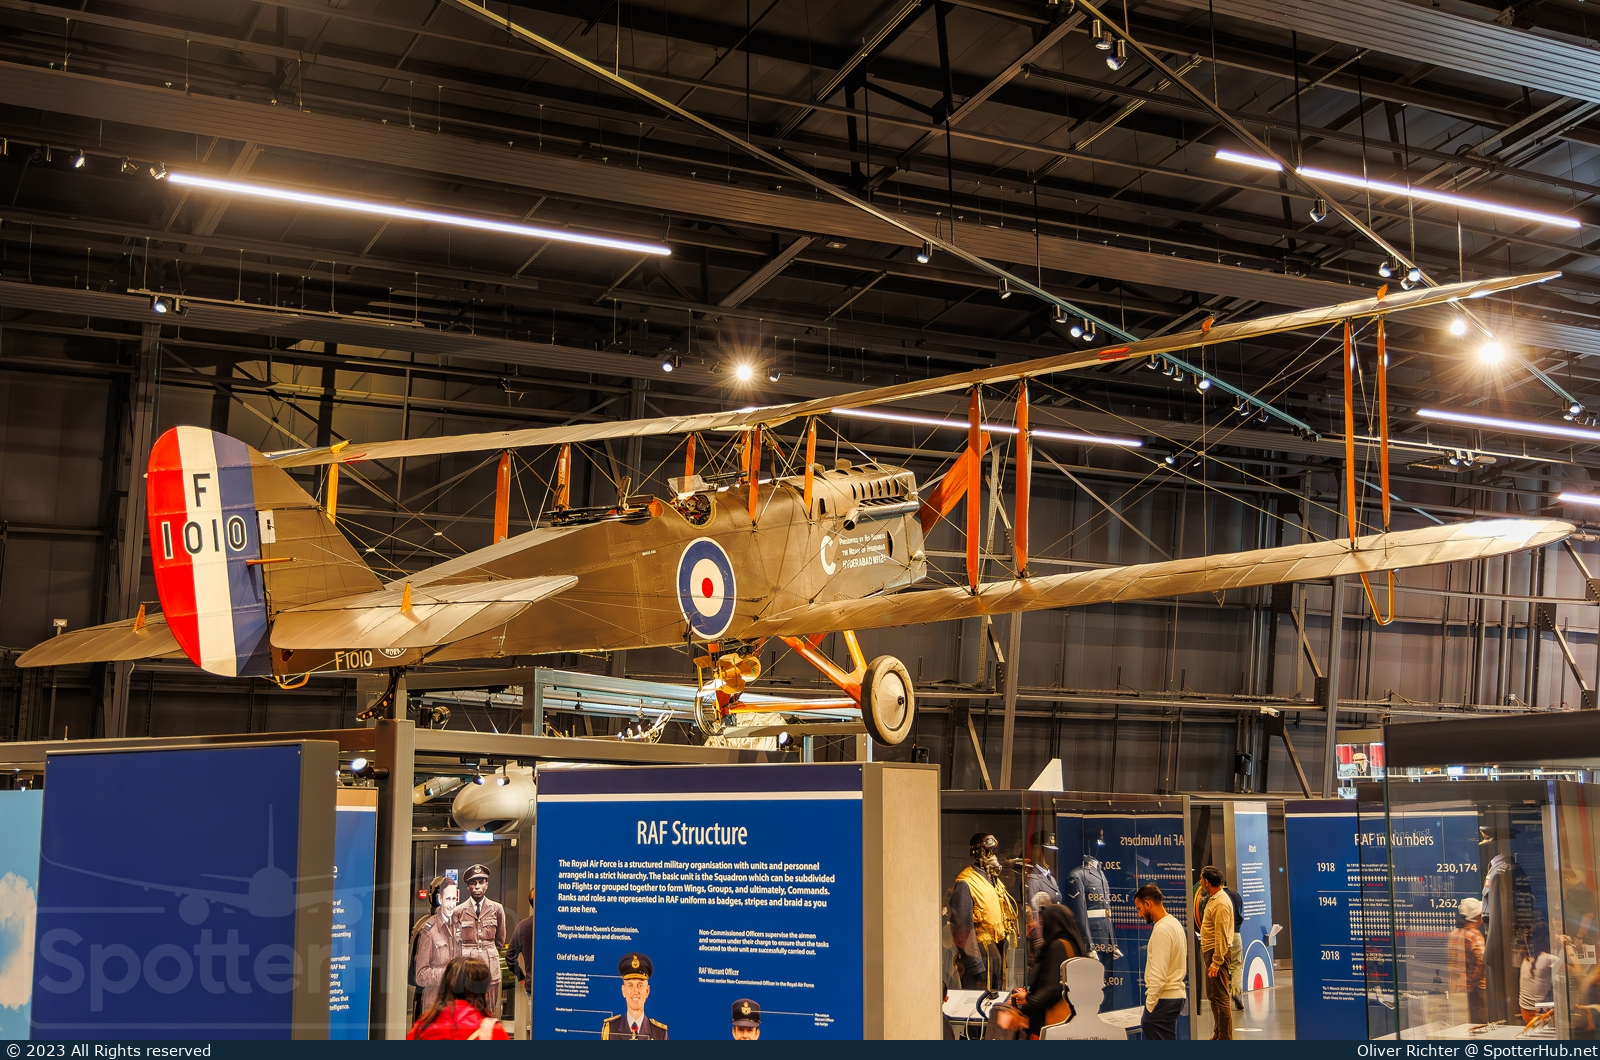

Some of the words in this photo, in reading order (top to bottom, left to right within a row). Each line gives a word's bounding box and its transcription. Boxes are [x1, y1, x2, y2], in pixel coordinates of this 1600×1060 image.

[193, 473, 210, 507] F
[162, 515, 247, 560] 1010
[820, 535, 836, 575] C
[335, 650, 372, 670] F1010
[638, 821, 668, 844] RAF
[672, 820, 747, 845] Structure
[1377, 833, 1386, 845] in
[1390, 833, 1434, 846] Numbers
[572, 860, 588, 869] Royal
[664, 861, 689, 870] military
[690, 861, 732, 871] organisation
[750, 862, 768, 870] units
[769, 862, 782, 870] and
[784, 862, 819, 872] personnel
[1316, 863, 1335, 872] 1918
[1436, 864, 1477, 873] 230,174
[559, 871, 586, 880] arranged
[617, 872, 648, 881] hierarchy.
[714, 873, 747, 882] Squadron
[795, 874, 835, 882] subdivided
[572, 883, 592, 891] Flights
[602, 883, 628, 892] grouped
[630, 883, 658, 893] together
[684, 884, 706, 894] Wings,
[708, 884, 733, 894] Groups,
[750, 885, 786, 895] ultimately,
[788, 886, 830, 894] Commands.
[618, 895, 656, 904] represented
[717, 897, 743, 906] badges,
[745, 897, 767, 907] stripes
[769, 898, 782, 906] and
[784, 898, 802, 906] braid
[1318, 897, 1337, 906] 1944
[1321, 951, 1339, 960] 2018
